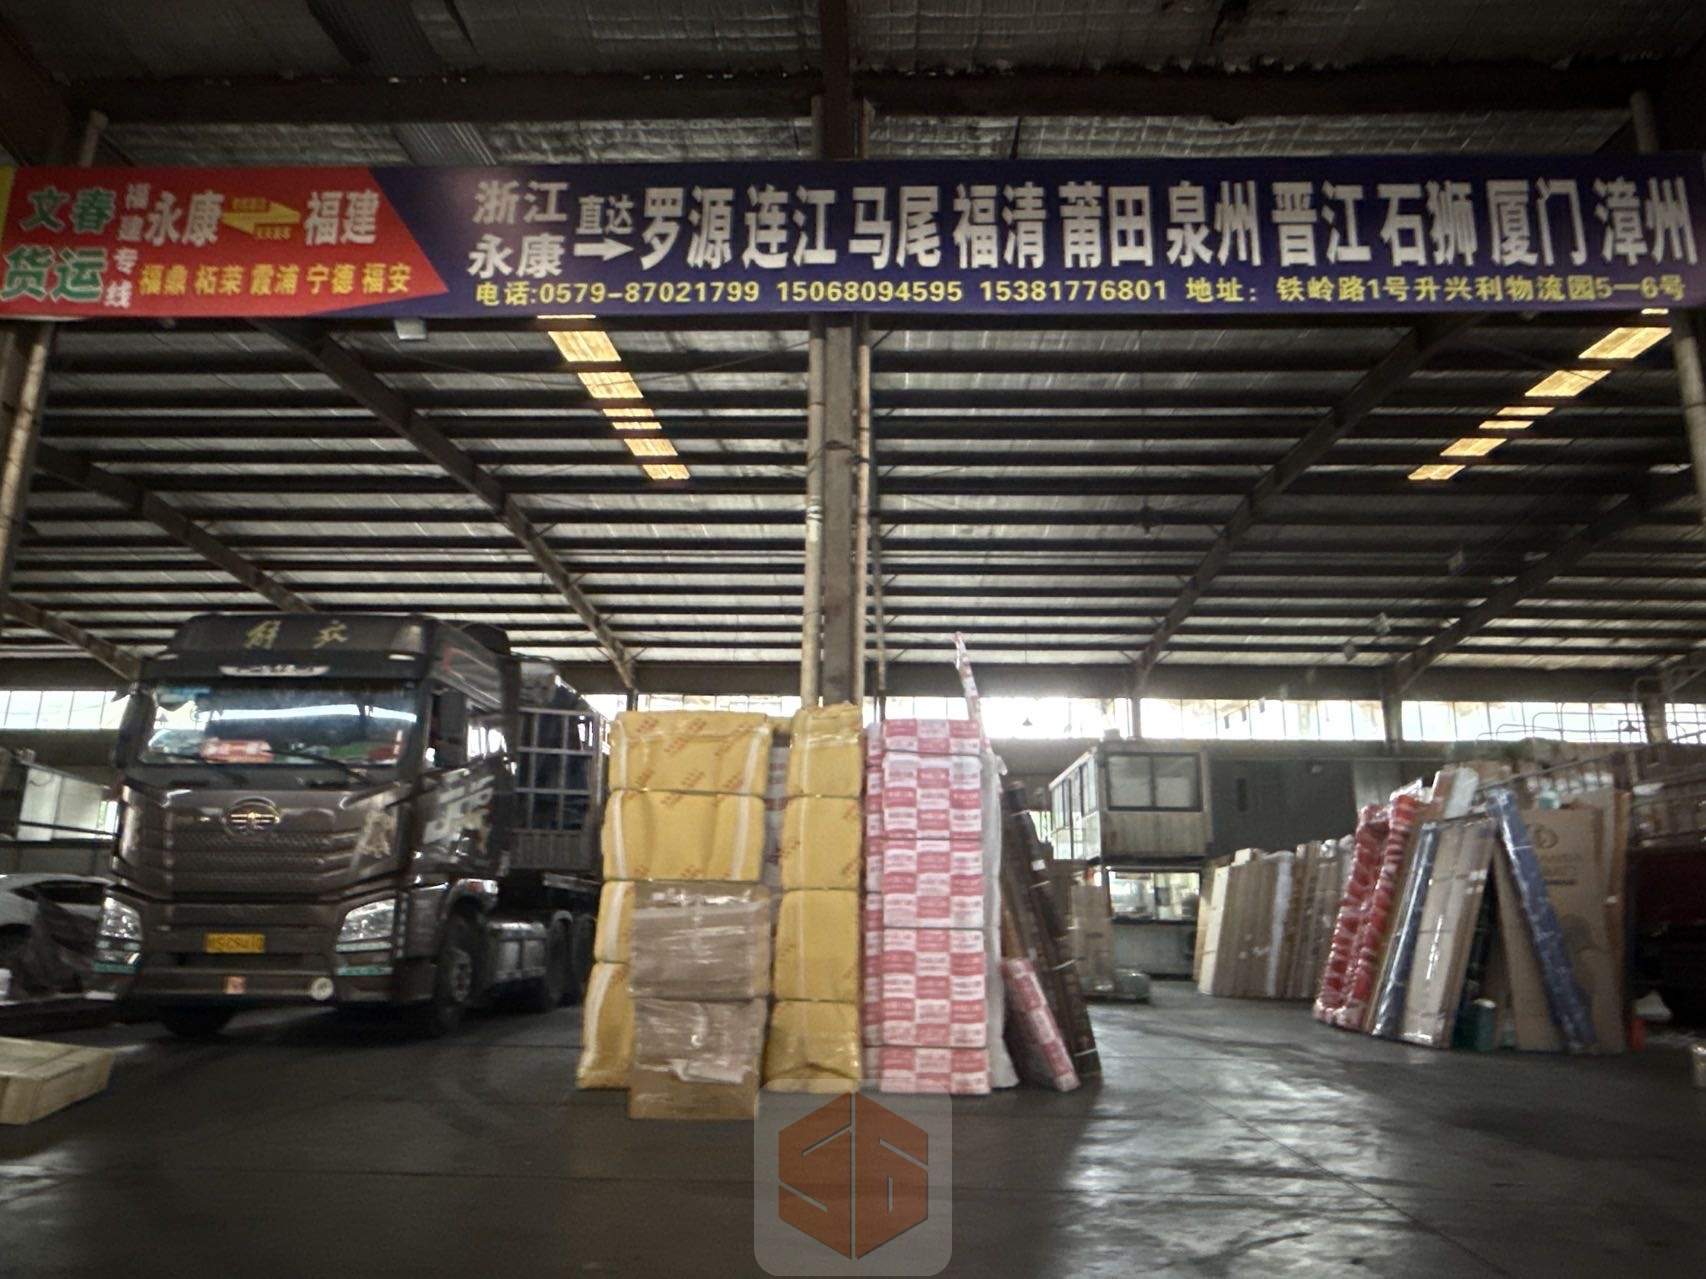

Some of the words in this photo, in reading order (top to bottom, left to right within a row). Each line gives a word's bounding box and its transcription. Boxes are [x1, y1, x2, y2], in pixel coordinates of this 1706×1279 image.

[20, 185, 117, 234] 文春
[145, 190, 225, 246] 永康
[304, 189, 379, 246] 福建
[473, 180, 570, 225] 浙江
[575, 194, 635, 235] 直达
[0, 244, 107, 303] 货运
[467, 233, 566, 279] 永康
[306, 263, 356, 296] 宁德
[362, 262, 412, 295] 福安
[776, 280, 963, 302] 15068094595
[979, 280, 1167, 302] 15381776801
